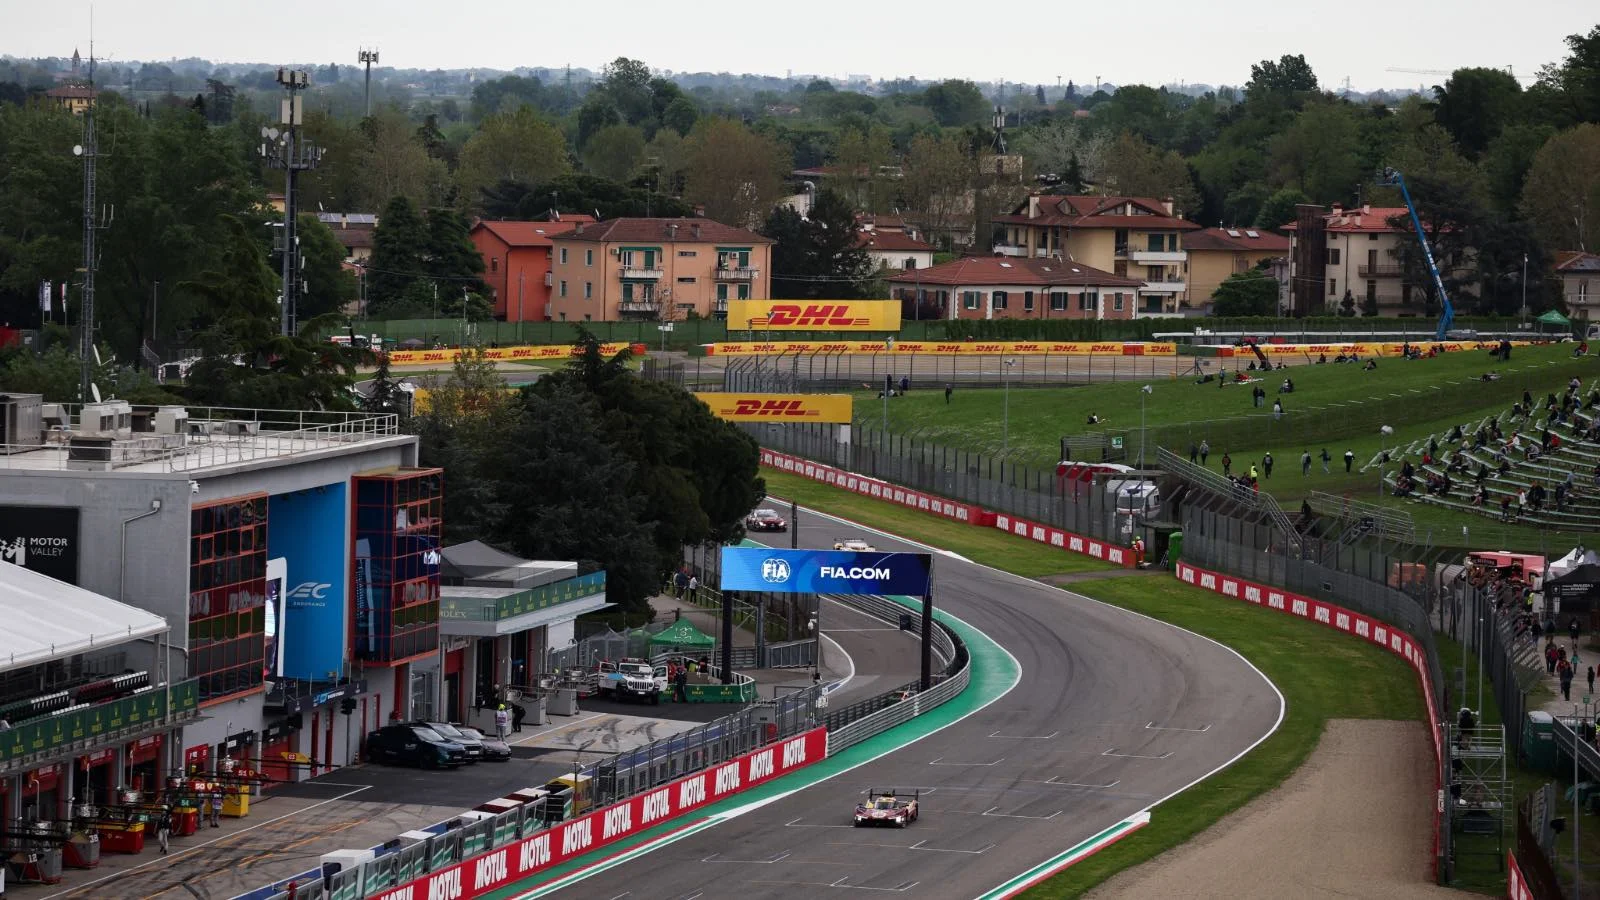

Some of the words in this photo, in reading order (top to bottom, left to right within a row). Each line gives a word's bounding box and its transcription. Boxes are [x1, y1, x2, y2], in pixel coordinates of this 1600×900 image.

[768, 305, 855, 326] DHL
[734, 400, 806, 416] DHL
[30, 538, 68, 546] MOTOR
[30, 548, 64, 556] VALLEY
[820, 566, 890, 580] FIA.COM
[429, 866, 462, 900] MOTUL
[474, 850, 508, 890] MOTUL
[519, 834, 550, 872] MOTUL
[562, 818, 592, 856] MOTUL
[603, 802, 632, 840] MOTUL
[642, 788, 670, 824] MOTUL
[679, 775, 706, 809] MOTUL
[715, 762, 740, 795] MOTUL
[749, 749, 774, 782] MOTUL
[783, 736, 806, 768] MOTUL
[28, 853, 38, 863] 12
